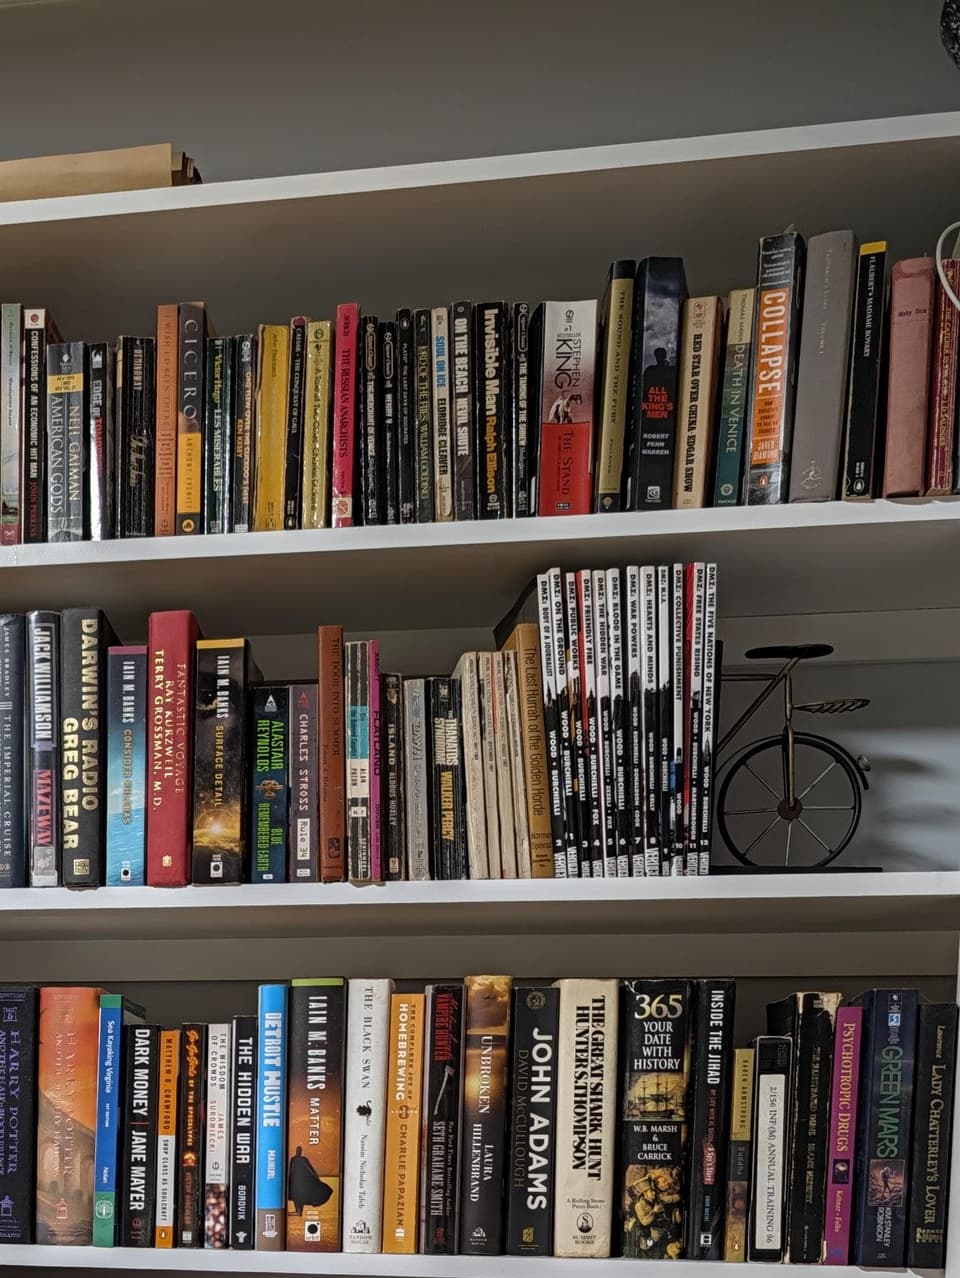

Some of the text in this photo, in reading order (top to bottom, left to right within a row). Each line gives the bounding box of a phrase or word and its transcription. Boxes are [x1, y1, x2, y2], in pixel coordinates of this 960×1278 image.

[183, 319, 199, 421] CICERO
[758, 289, 786, 394] COLLAPSE
[50, 396, 64, 514] AMERICAN GODS
[80, 618, 98, 811] DARWIN'S RADIO
[256, 719, 270, 772] REYNOLDS
[270, 720, 284, 770] ALASTAIR
[63, 717, 79, 849] GREG BEAR
[308, 995, 327, 1024] IAIN
[634, 994, 683, 1020] 365
[643, 1022, 673, 1033] YOUR
[644, 1034, 672, 1045] DATE
[132, 1028, 151, 1117] DARK MONEY
[262, 1012, 282, 1127] DETROIT HUSTLE
[306, 1050, 326, 1090] BANKS
[395, 1003, 408, 1101] HOMEBREWING
[479, 1036, 492, 1114] UNBROKEN
[634, 1058, 680, 1070] HISTORY
[642, 1045, 672, 1057] WITH
[236, 1037, 252, 1164] THE HIDDEN WAR
[308, 1098, 320, 1146] MATTER
[526, 1027, 553, 1211] JOHN ADAMS
[129, 1130, 147, 1211] JANE MAYER
